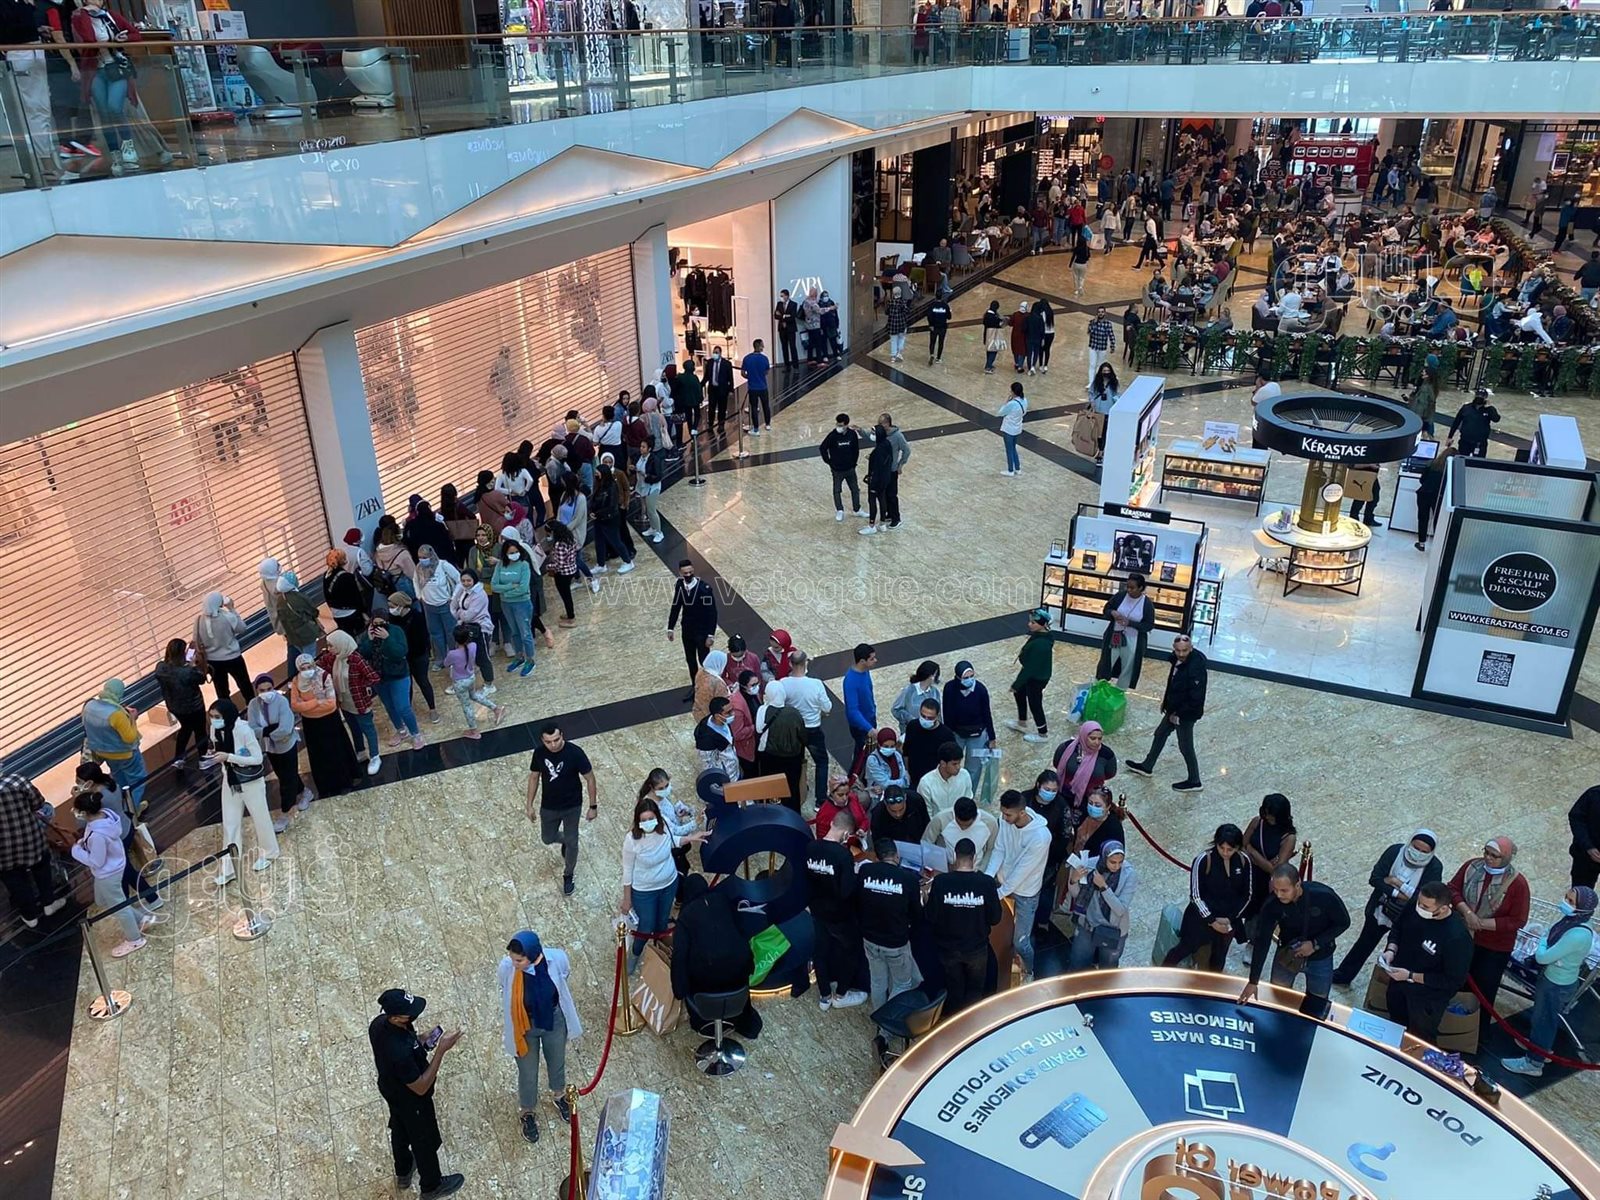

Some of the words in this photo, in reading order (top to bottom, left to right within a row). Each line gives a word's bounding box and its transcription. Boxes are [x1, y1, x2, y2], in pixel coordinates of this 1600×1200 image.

[790, 276, 825, 298] ZARA
[1301, 437, 1368, 457] KÉRASTASE
[355, 496, 382, 521] ZARA
[1494, 566, 1522, 577] FREE
[1523, 570, 1550, 581] HAIR
[1497, 576, 1507, 584] &
[1507, 577, 1542, 589] SCALP
[1488, 583, 1547, 599] DIAGNOSIS
[1449, 611, 1570, 638] WWW.KERASTASE.COM.EG
[1149, 1010, 1255, 1034] MEMORIES
[1040, 1027, 1081, 1048] HAIR
[1150, 1030, 1205, 1044] MAKE
[1208, 1033, 1257, 1053] LETS
[988, 1042, 1037, 1074] BLIND
[1038, 1045, 1088, 1073] BRAID
[937, 1069, 993, 1124] FOLDED
[1360, 1065, 1423, 1106] QUIZ
[963, 1068, 1038, 1134] SOMEONE'S
[1426, 1107, 1484, 1147] POP
